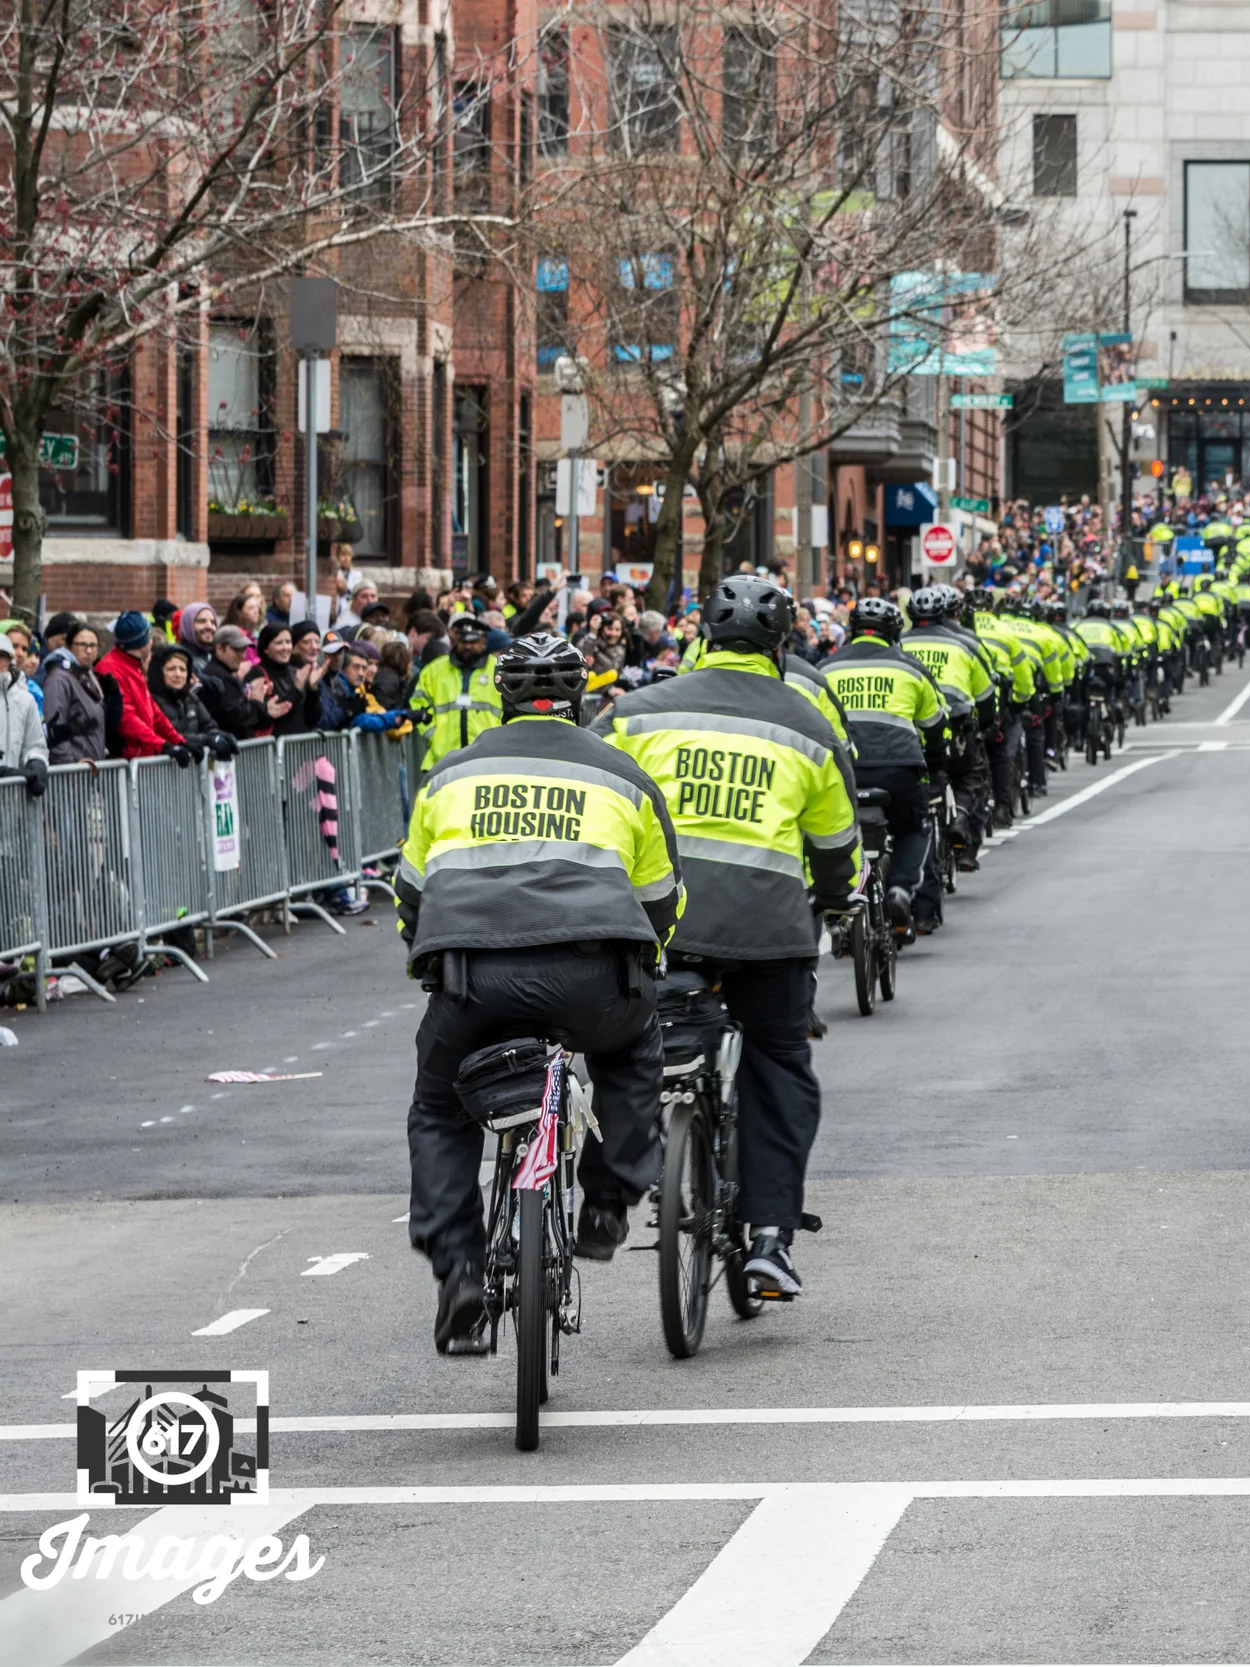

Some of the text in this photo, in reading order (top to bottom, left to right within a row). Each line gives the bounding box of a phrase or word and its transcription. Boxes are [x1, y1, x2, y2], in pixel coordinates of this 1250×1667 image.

[911, 650, 949, 665] OSTON
[837, 676, 894, 694] BOSTON
[841, 693, 889, 709] POLICE
[675, 748, 776, 791] BOSTON
[474, 784, 587, 816] BOSTON
[678, 781, 767, 824] POLICE
[471, 811, 582, 842] HOUSING
